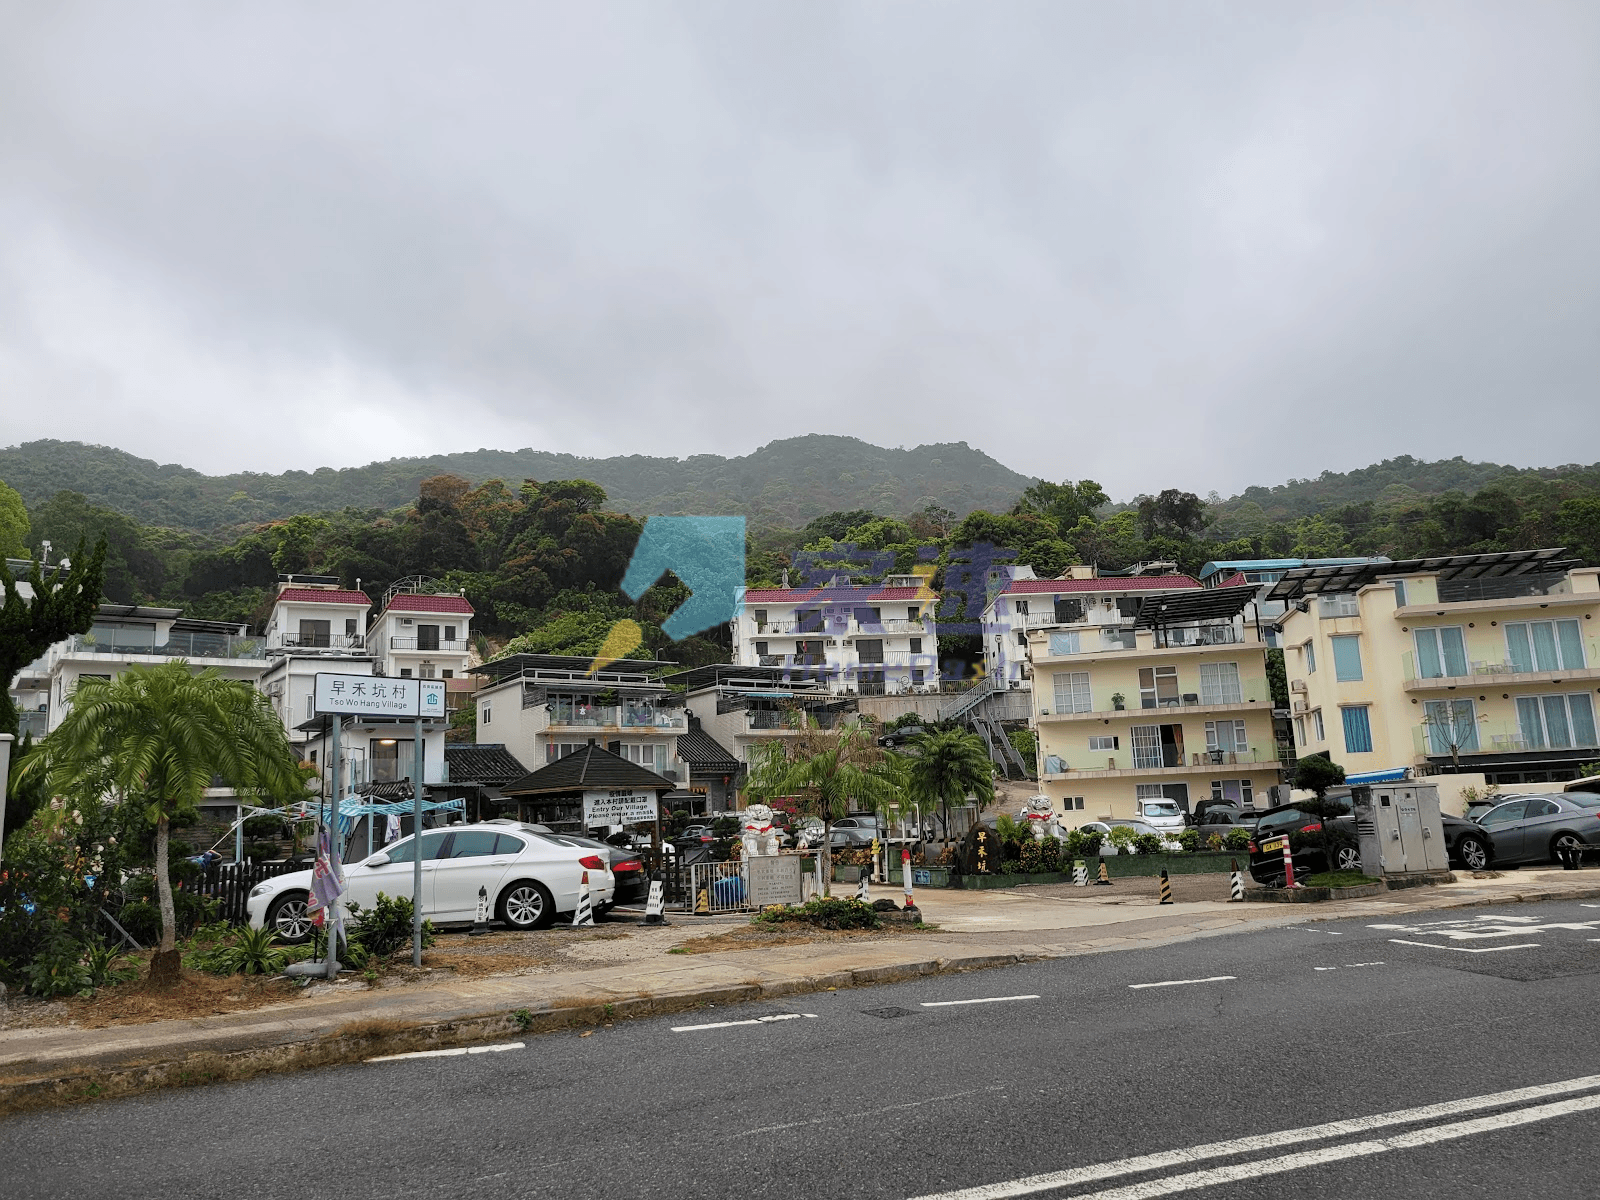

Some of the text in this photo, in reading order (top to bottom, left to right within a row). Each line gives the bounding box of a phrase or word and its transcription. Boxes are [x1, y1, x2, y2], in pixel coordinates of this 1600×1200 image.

[330, 681, 407, 699] 早禾坑村
[329, 697, 344, 706] Tso
[360, 699, 380, 709] Hang
[381, 700, 408, 709] Village
[976, 831, 989, 872] 早禾坑
